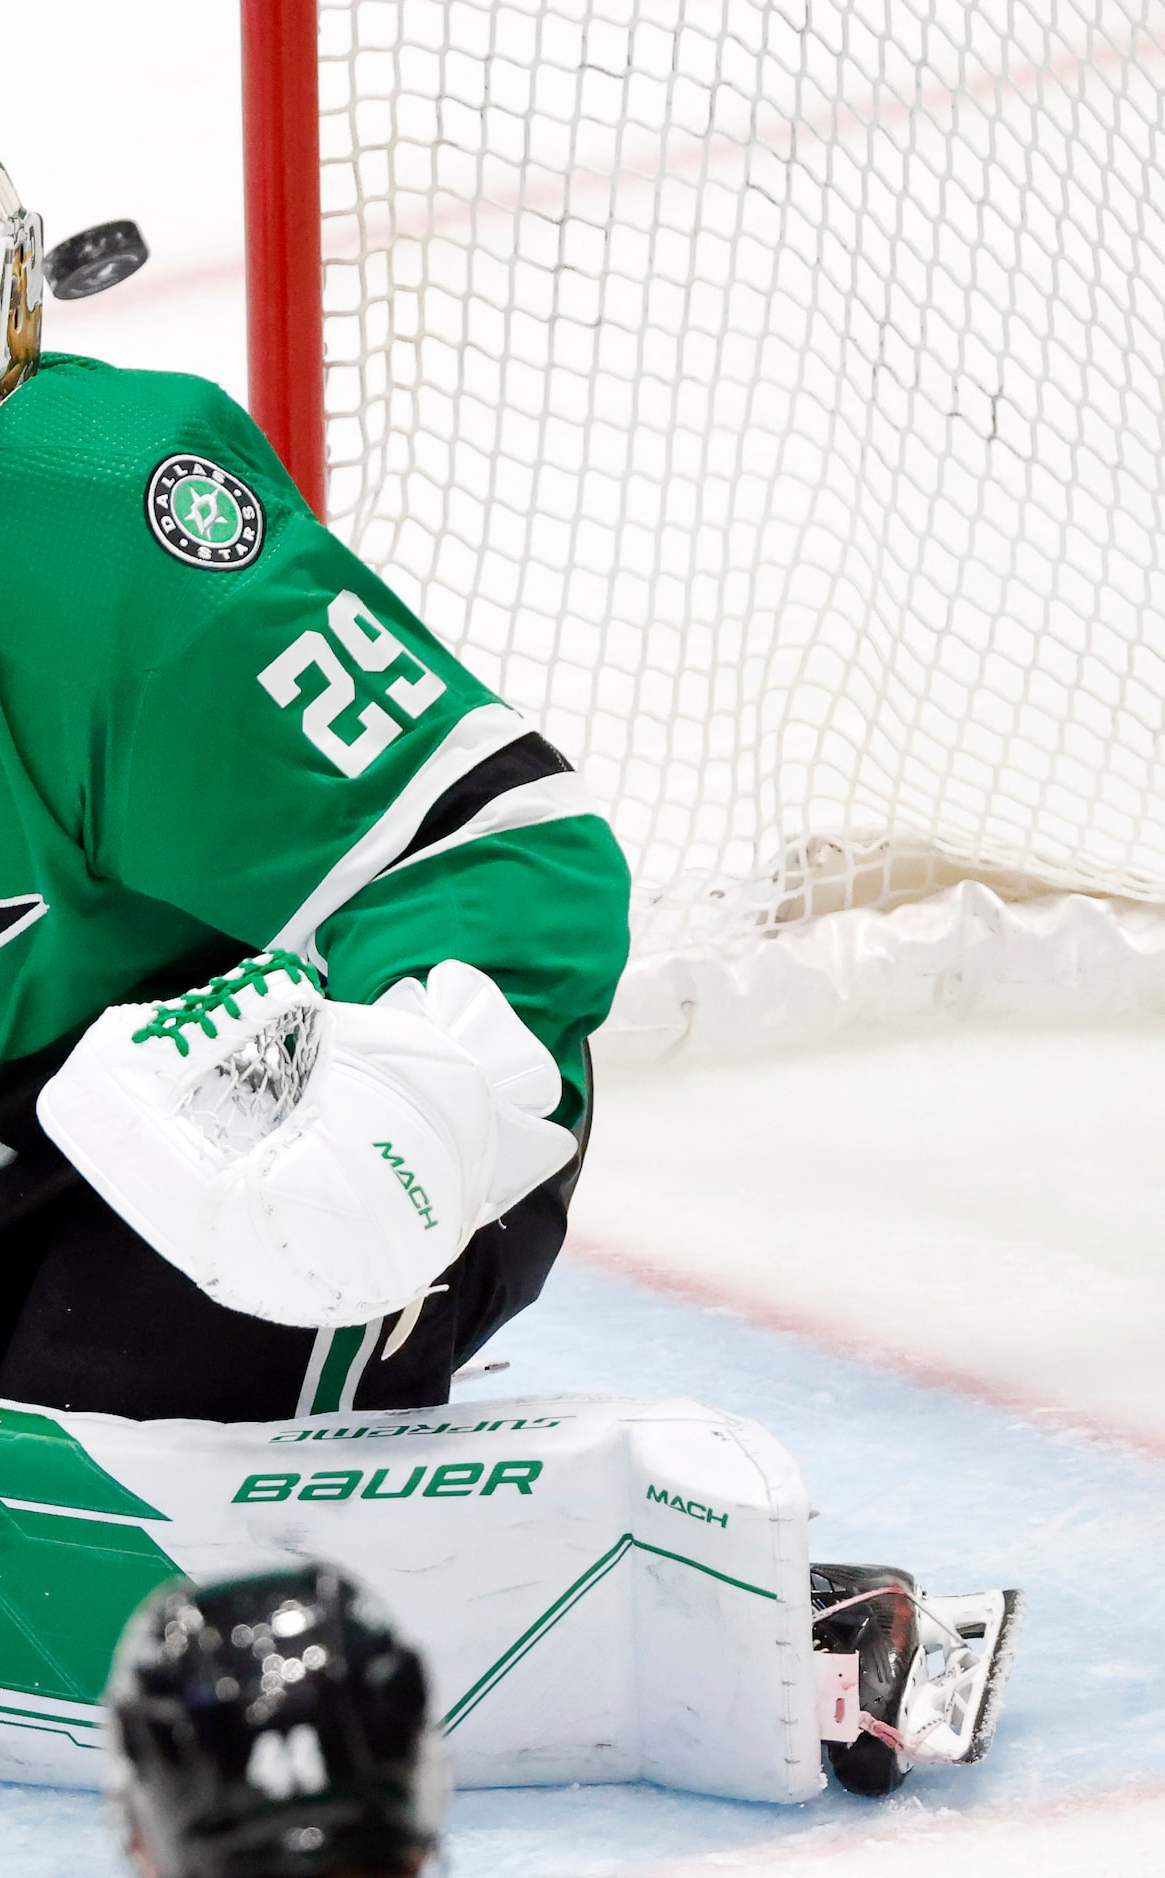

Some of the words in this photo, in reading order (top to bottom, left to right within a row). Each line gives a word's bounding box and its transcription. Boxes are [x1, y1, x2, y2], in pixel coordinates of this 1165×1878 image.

[155, 463, 226, 534] DALLAS
[197, 505, 255, 560] STARS
[256, 589, 447, 780] 29
[372, 1141, 437, 1230] MACH
[268, 1416, 563, 1444] SUPREME
[231, 1460, 544, 1503] BAUER
[646, 1484, 729, 1529] MACH
